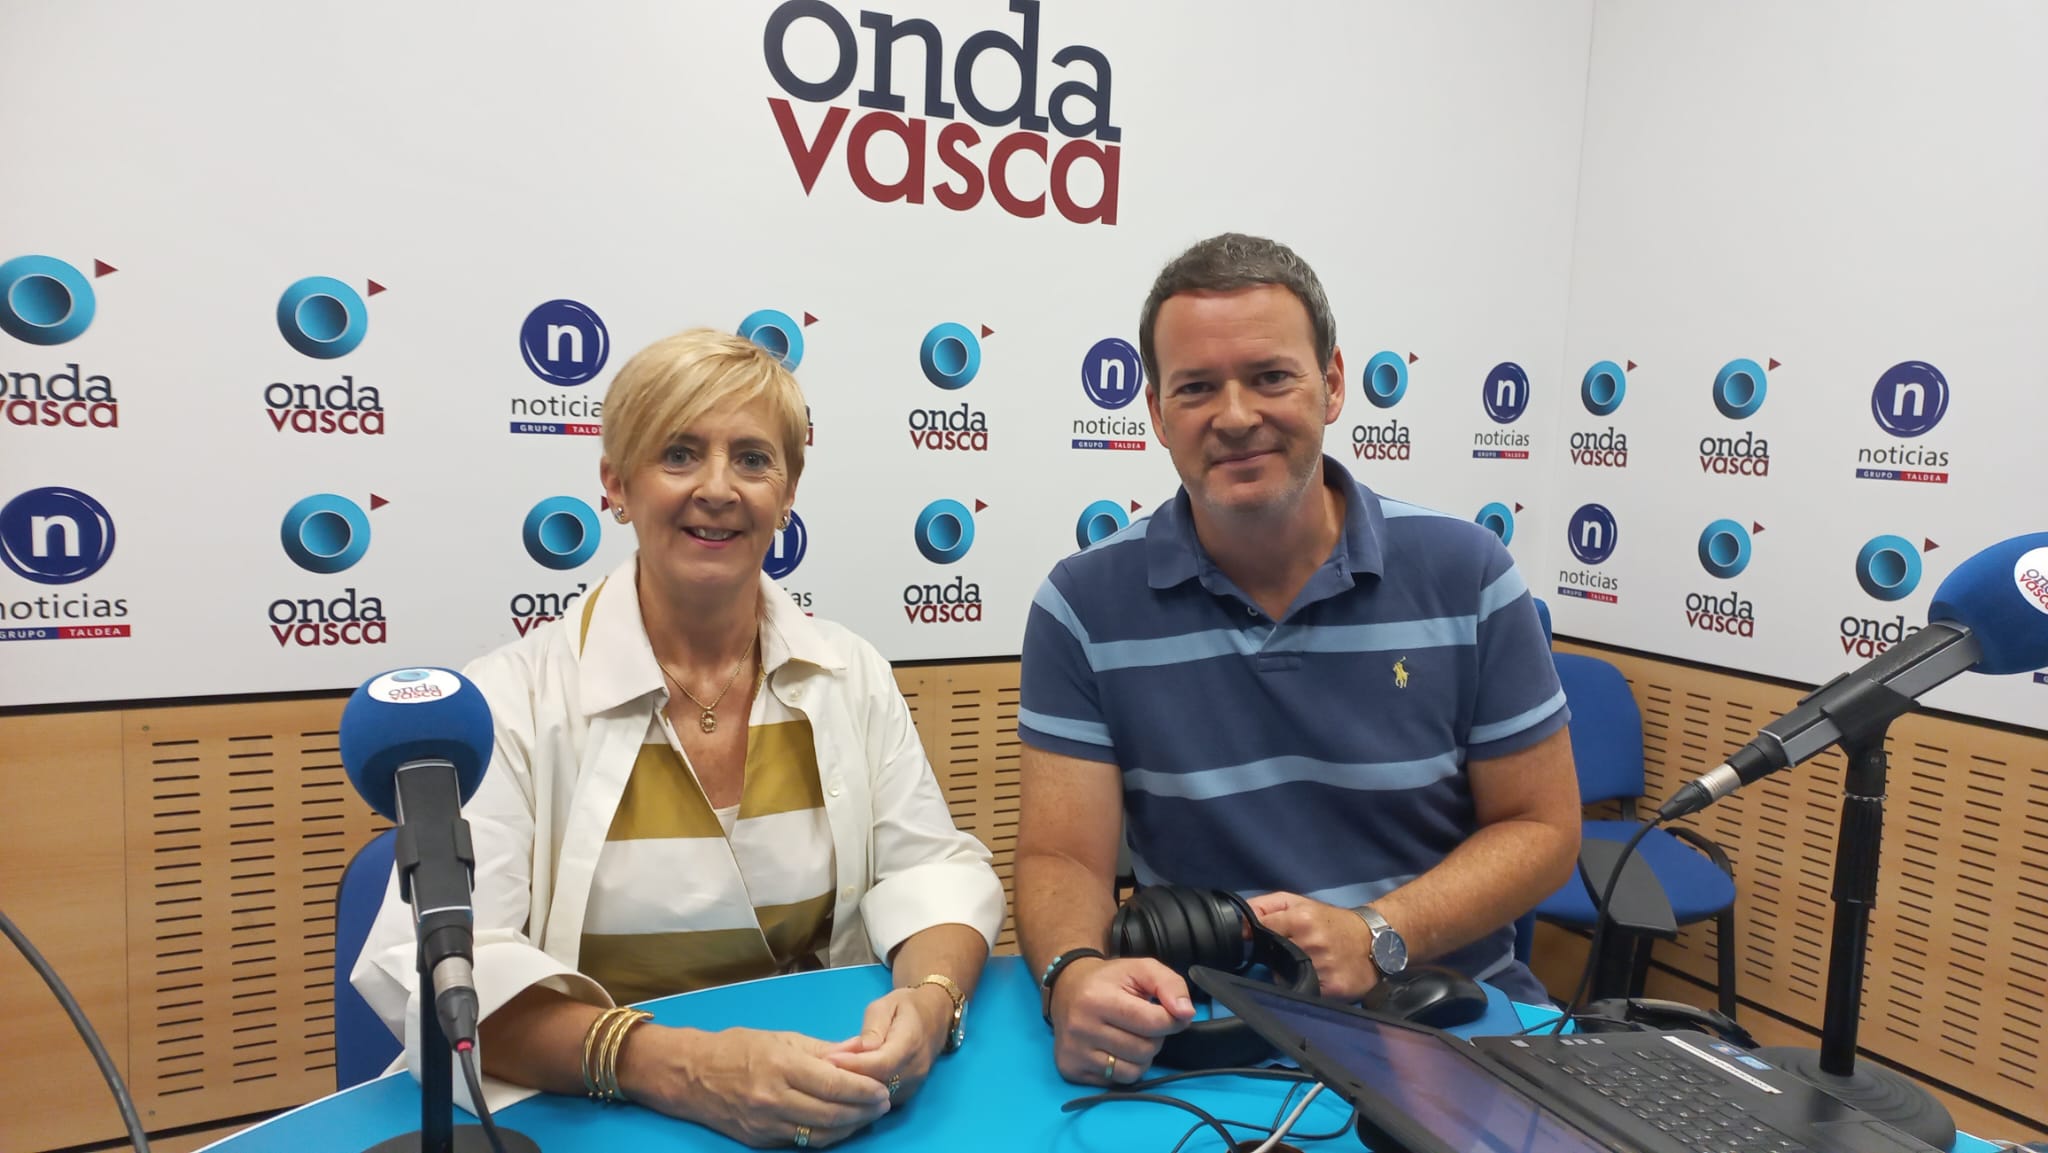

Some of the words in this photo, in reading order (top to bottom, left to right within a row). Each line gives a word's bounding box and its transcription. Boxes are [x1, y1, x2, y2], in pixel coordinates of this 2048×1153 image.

[763, 0, 1122, 143] onda
[767, 97, 1121, 226] vasca
[548, 324, 584, 362] n
[0, 363, 117, 403] nda
[1100, 358, 1125, 390] n
[264, 375, 384, 411] onda
[511, 394, 603, 418] noticia
[1496, 379, 1516, 407] n
[1893, 382, 1925, 416] n
[0, 400, 118, 428] asca
[266, 408, 385, 434] vasca
[909, 403, 988, 432] onda
[1073, 416, 1146, 436] noticias
[519, 424, 557, 433] GRUPO
[572, 426, 603, 434] TALD
[909, 430, 988, 451] vasca
[1352, 419, 1410, 444] onda
[1474, 429, 1530, 447] noticias
[1570, 426, 1628, 451] onda
[1078, 441, 1104, 449] GRUPO
[1114, 442, 1141, 450] TALDEA
[1352, 442, 1410, 461] vasca
[1699, 431, 1769, 459] onda
[1858, 444, 1949, 467] noticias
[1570, 448, 1628, 469] vasca
[1699, 455, 1769, 477] vasca
[1863, 470, 1894, 479] GRUPO
[1906, 472, 1942, 482] TALDEA
[31, 514, 80, 557] n
[1581, 519, 1602, 549] n
[904, 576, 982, 605] onda
[1559, 569, 1618, 591] noticias
[2026, 568, 2048, 595] on
[268, 588, 387, 625] onda
[904, 602, 982, 624] vasca
[1685, 590, 1754, 620] onda
[0, 630, 46, 639] GRUPO
[69, 628, 121, 637] TALDEA
[270, 621, 387, 648] vasca
[1686, 609, 1754, 638] vasca
[1840, 635, 1888, 659] vas
[388, 683, 440, 696] onda
